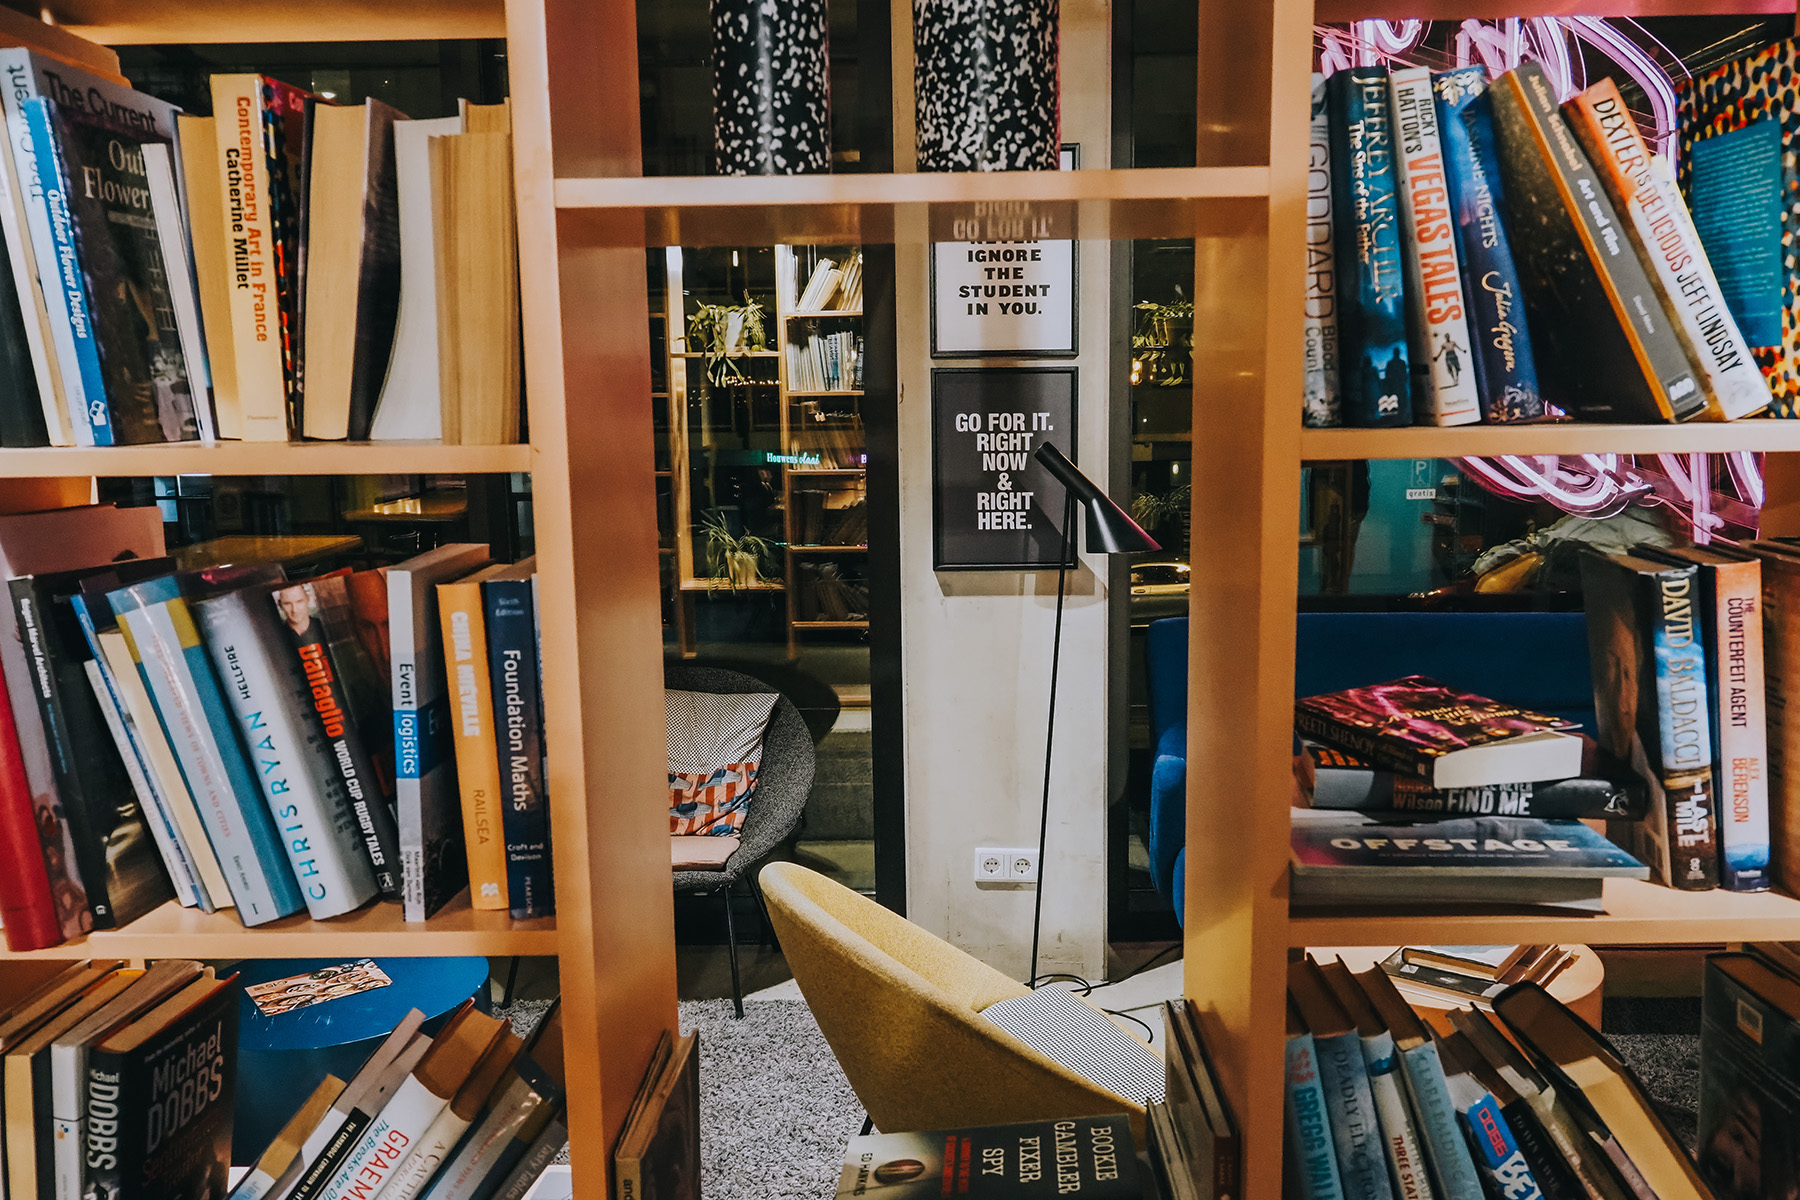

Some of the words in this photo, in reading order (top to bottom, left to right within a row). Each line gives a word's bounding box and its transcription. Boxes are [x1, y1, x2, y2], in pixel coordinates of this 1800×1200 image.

[43, 70, 83, 111] The
[87, 86, 157, 133] Current
[1419, 98, 1436, 137] RICKY
[1352, 75, 1390, 178] JEFFREY
[1593, 98, 1645, 174] DEXTER
[237, 97, 259, 222] Contemporary
[1634, 169, 1651, 188] IS
[226, 148, 244, 232] Catherine
[1408, 152, 1450, 244] VEGAS
[1304, 143, 1334, 319] GODDARD
[1475, 186, 1498, 249] NIGHTS
[1635, 185, 1692, 272] DELICIOUS
[233, 238, 250, 289] Millet
[247, 227, 262, 256] Art
[967, 249, 1042, 263] IGNORE
[251, 261, 264, 277] in
[984, 267, 1024, 280] THE
[1420, 244, 1462, 325] TALES
[1677, 271, 1711, 307] JEFF
[252, 283, 267, 342] France
[959, 285, 1051, 298] STUDENT
[967, 303, 988, 315] IN
[999, 302, 1042, 315] YOU.
[1321, 325, 1336, 371] Blood
[1695, 306, 1743, 374] LINDSAY
[956, 413, 982, 432] GO
[988, 412, 1025, 432] FOR
[1032, 412, 1054, 431] IT.
[976, 432, 1034, 452] RIGHT
[982, 452, 1027, 471] NOW
[997, 472, 1013, 491] &
[1415, 460, 1427, 475] P
[977, 491, 1034, 511] RIGHT
[1408, 489, 1434, 498] gratis
[977, 511, 1033, 530] HERE.
[1661, 577, 1694, 648] DAVID
[1728, 597, 1746, 684] COUNTERFEIT
[224, 645, 250, 700] HELLFIRE
[298, 643, 345, 738] Dallaglio
[400, 663, 414, 706] Event
[503, 650, 527, 751] Foundation
[1668, 658, 1701, 765] BALDACCI
[1731, 687, 1748, 728] AGENT
[244, 711, 290, 796] RYAN
[333, 739, 356, 778] WORLD
[398, 713, 418, 775] logistics
[346, 778, 363, 800] CUP
[510, 756, 531, 812] Maths
[1393, 790, 1443, 810] Wilson
[1446, 789, 1494, 815] FIND
[1498, 792, 1534, 816] ME
[1732, 757, 1749, 823] BERENSON
[353, 800, 375, 835] RUGBY
[473, 789, 490, 845] RAILSEA
[1675, 801, 1696, 848] MILE
[280, 804, 326, 900] CHRIS
[365, 833, 385, 866] TALES
[1329, 838, 1580, 851] OFFSTAGE
[153, 1020, 222, 1102] Michael
[87, 1081, 119, 1170] DOBBS
[147, 1055, 223, 1154] DOBBS
[374, 1119, 390, 1137] The
[346, 1136, 377, 1173] Breaks
[532, 1143, 556, 1172] Tasty
[981, 1147, 1005, 1178] SPY
[1019, 1136, 1042, 1184] FIXER
[1053, 1121, 1081, 1195] GAMBLER
[1090, 1125, 1119, 1182] BOOKIE
[1392, 1134, 1411, 1171] THREE
[336, 1173, 350, 1189] Are
[506, 1168, 538, 1200] Tables
